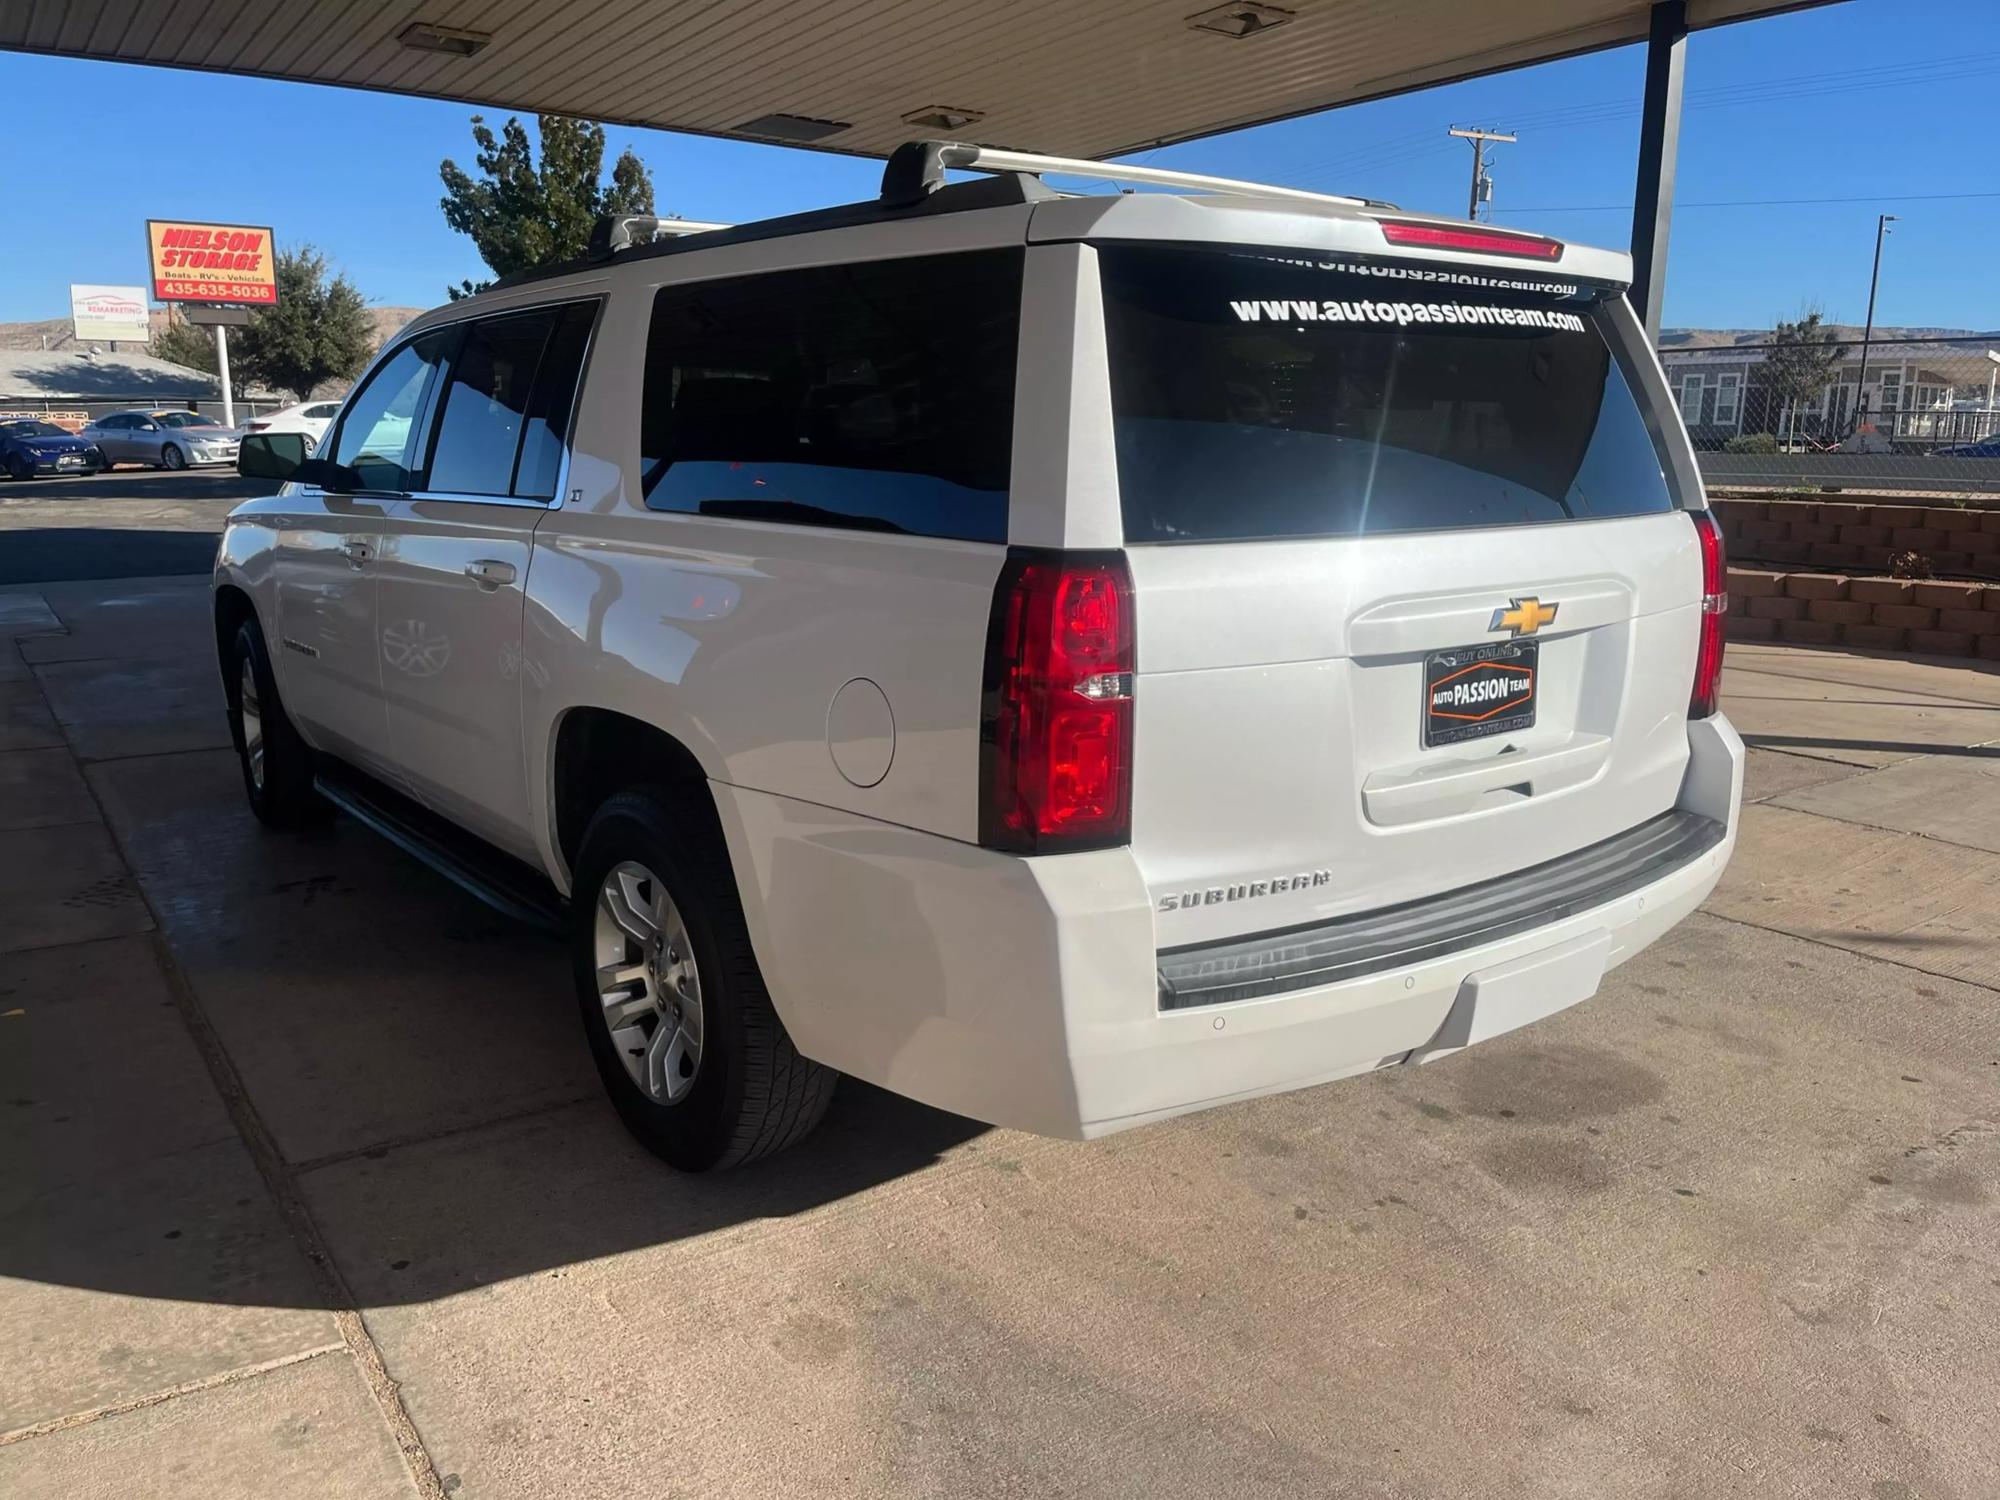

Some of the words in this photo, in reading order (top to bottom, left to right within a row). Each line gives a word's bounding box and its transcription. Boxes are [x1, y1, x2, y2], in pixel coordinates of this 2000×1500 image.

[161, 228, 263, 252] NIELSON
[161, 249, 262, 271] STORAGE
[227, 274, 265, 282] Vehicles
[164, 282, 269, 298] 435-635-5036
[88, 306, 142, 314] REMARKETING
[1229, 300, 1586, 333] www.autopassionteam.com
[1432, 691, 1454, 705] AUTO
[1454, 677, 1508, 706] PASSION
[1509, 678, 1530, 692] TEAM
[1157, 868, 1332, 913] SUBURBAN
